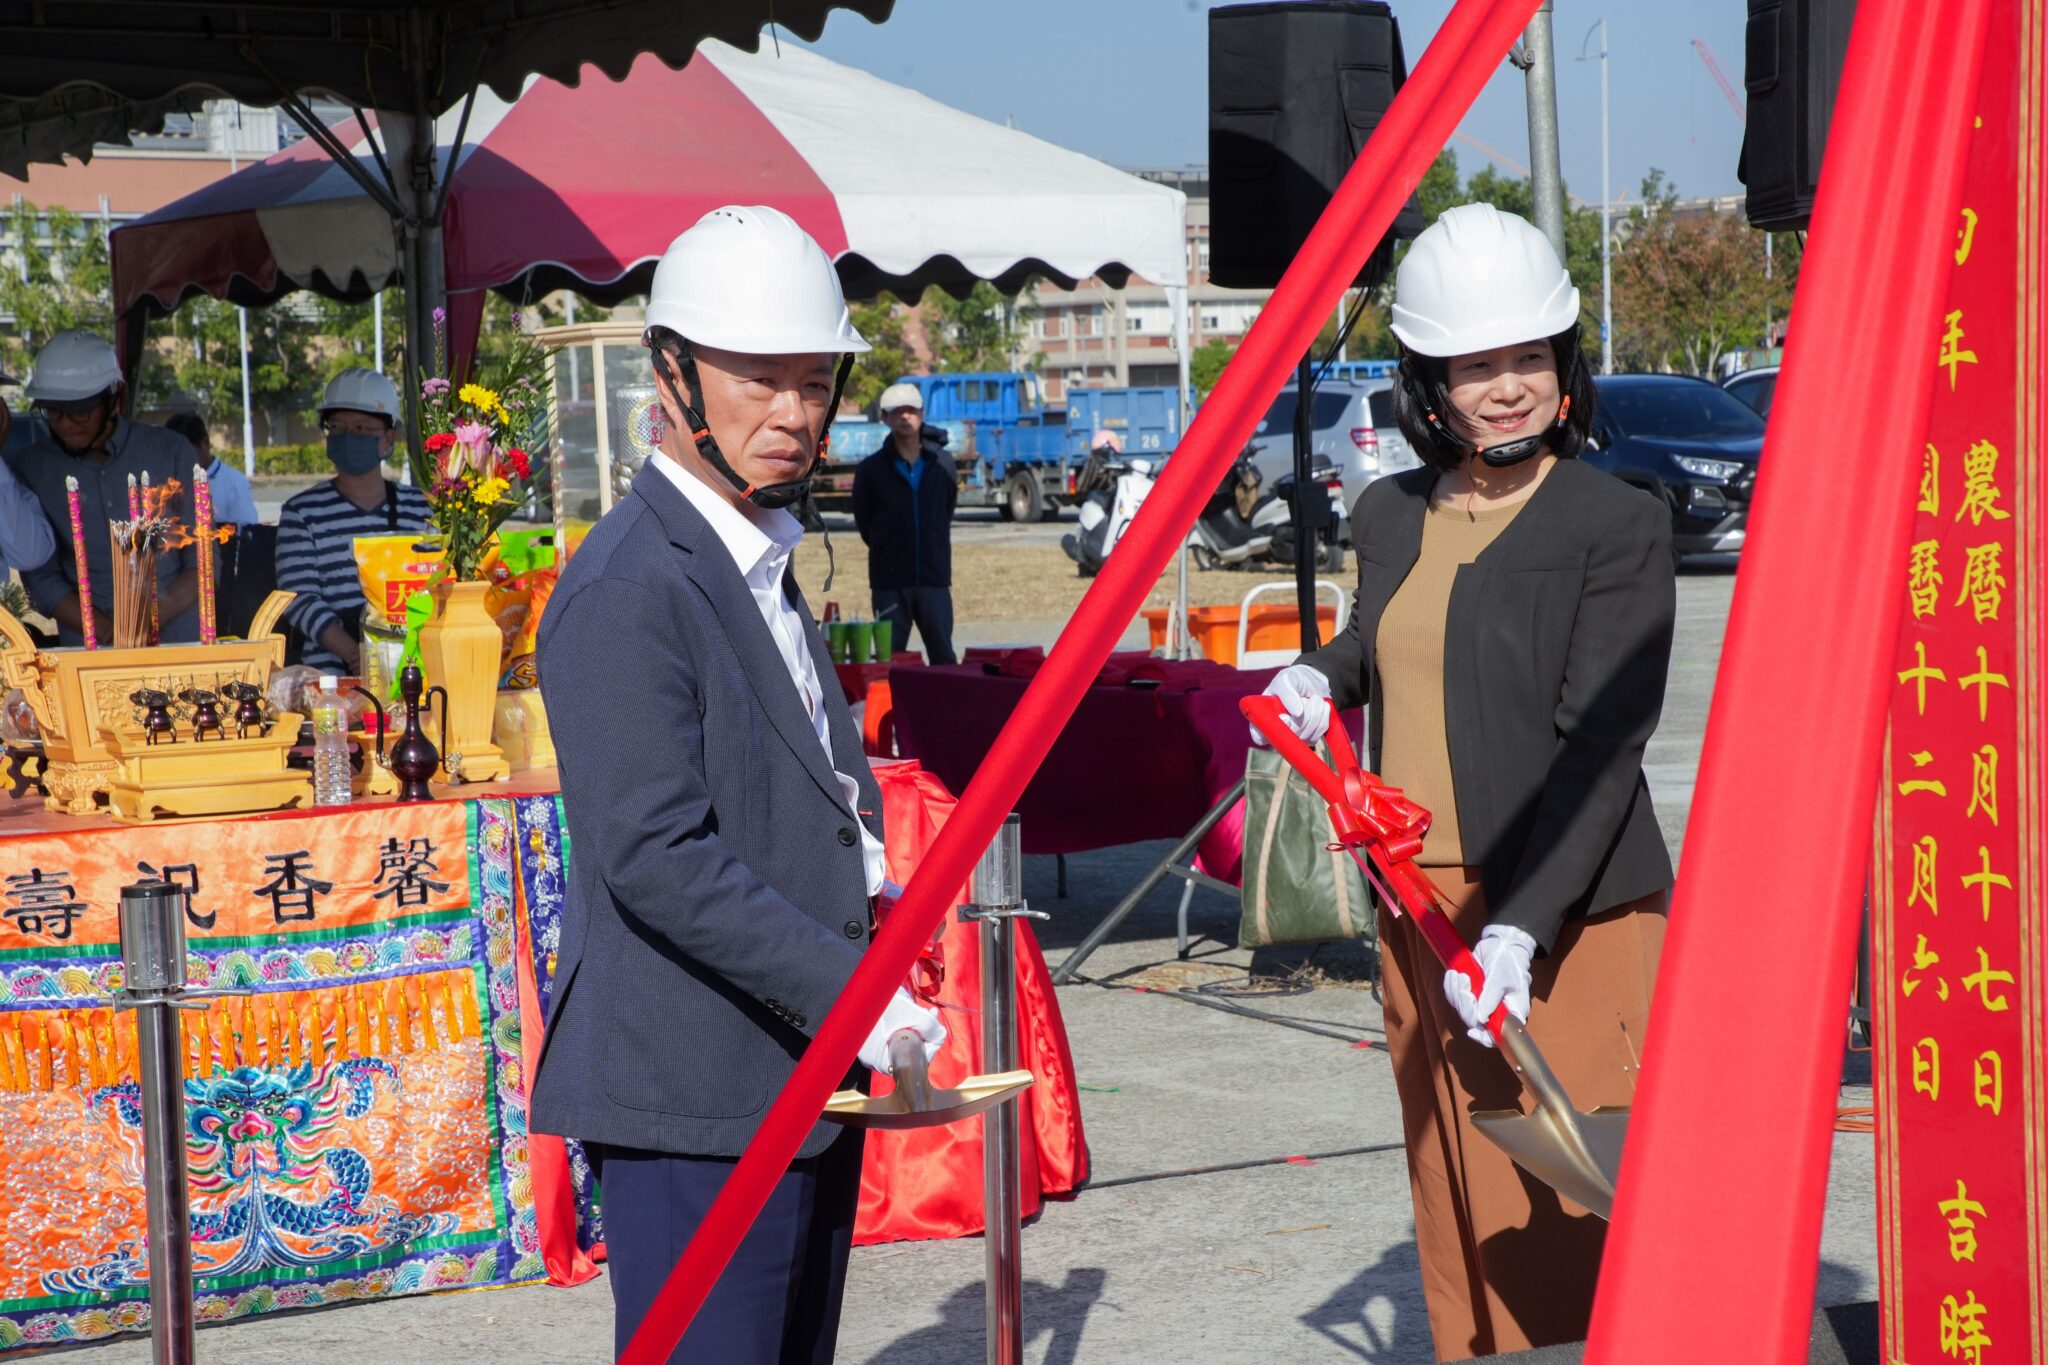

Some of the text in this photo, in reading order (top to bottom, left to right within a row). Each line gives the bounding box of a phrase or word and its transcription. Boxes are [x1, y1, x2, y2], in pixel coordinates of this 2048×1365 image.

[1141, 434, 1160, 450] 26
[1954, 438, 2015, 1117] 農曆十月十七日
[1937, 1178, 1992, 1365] 吉時
